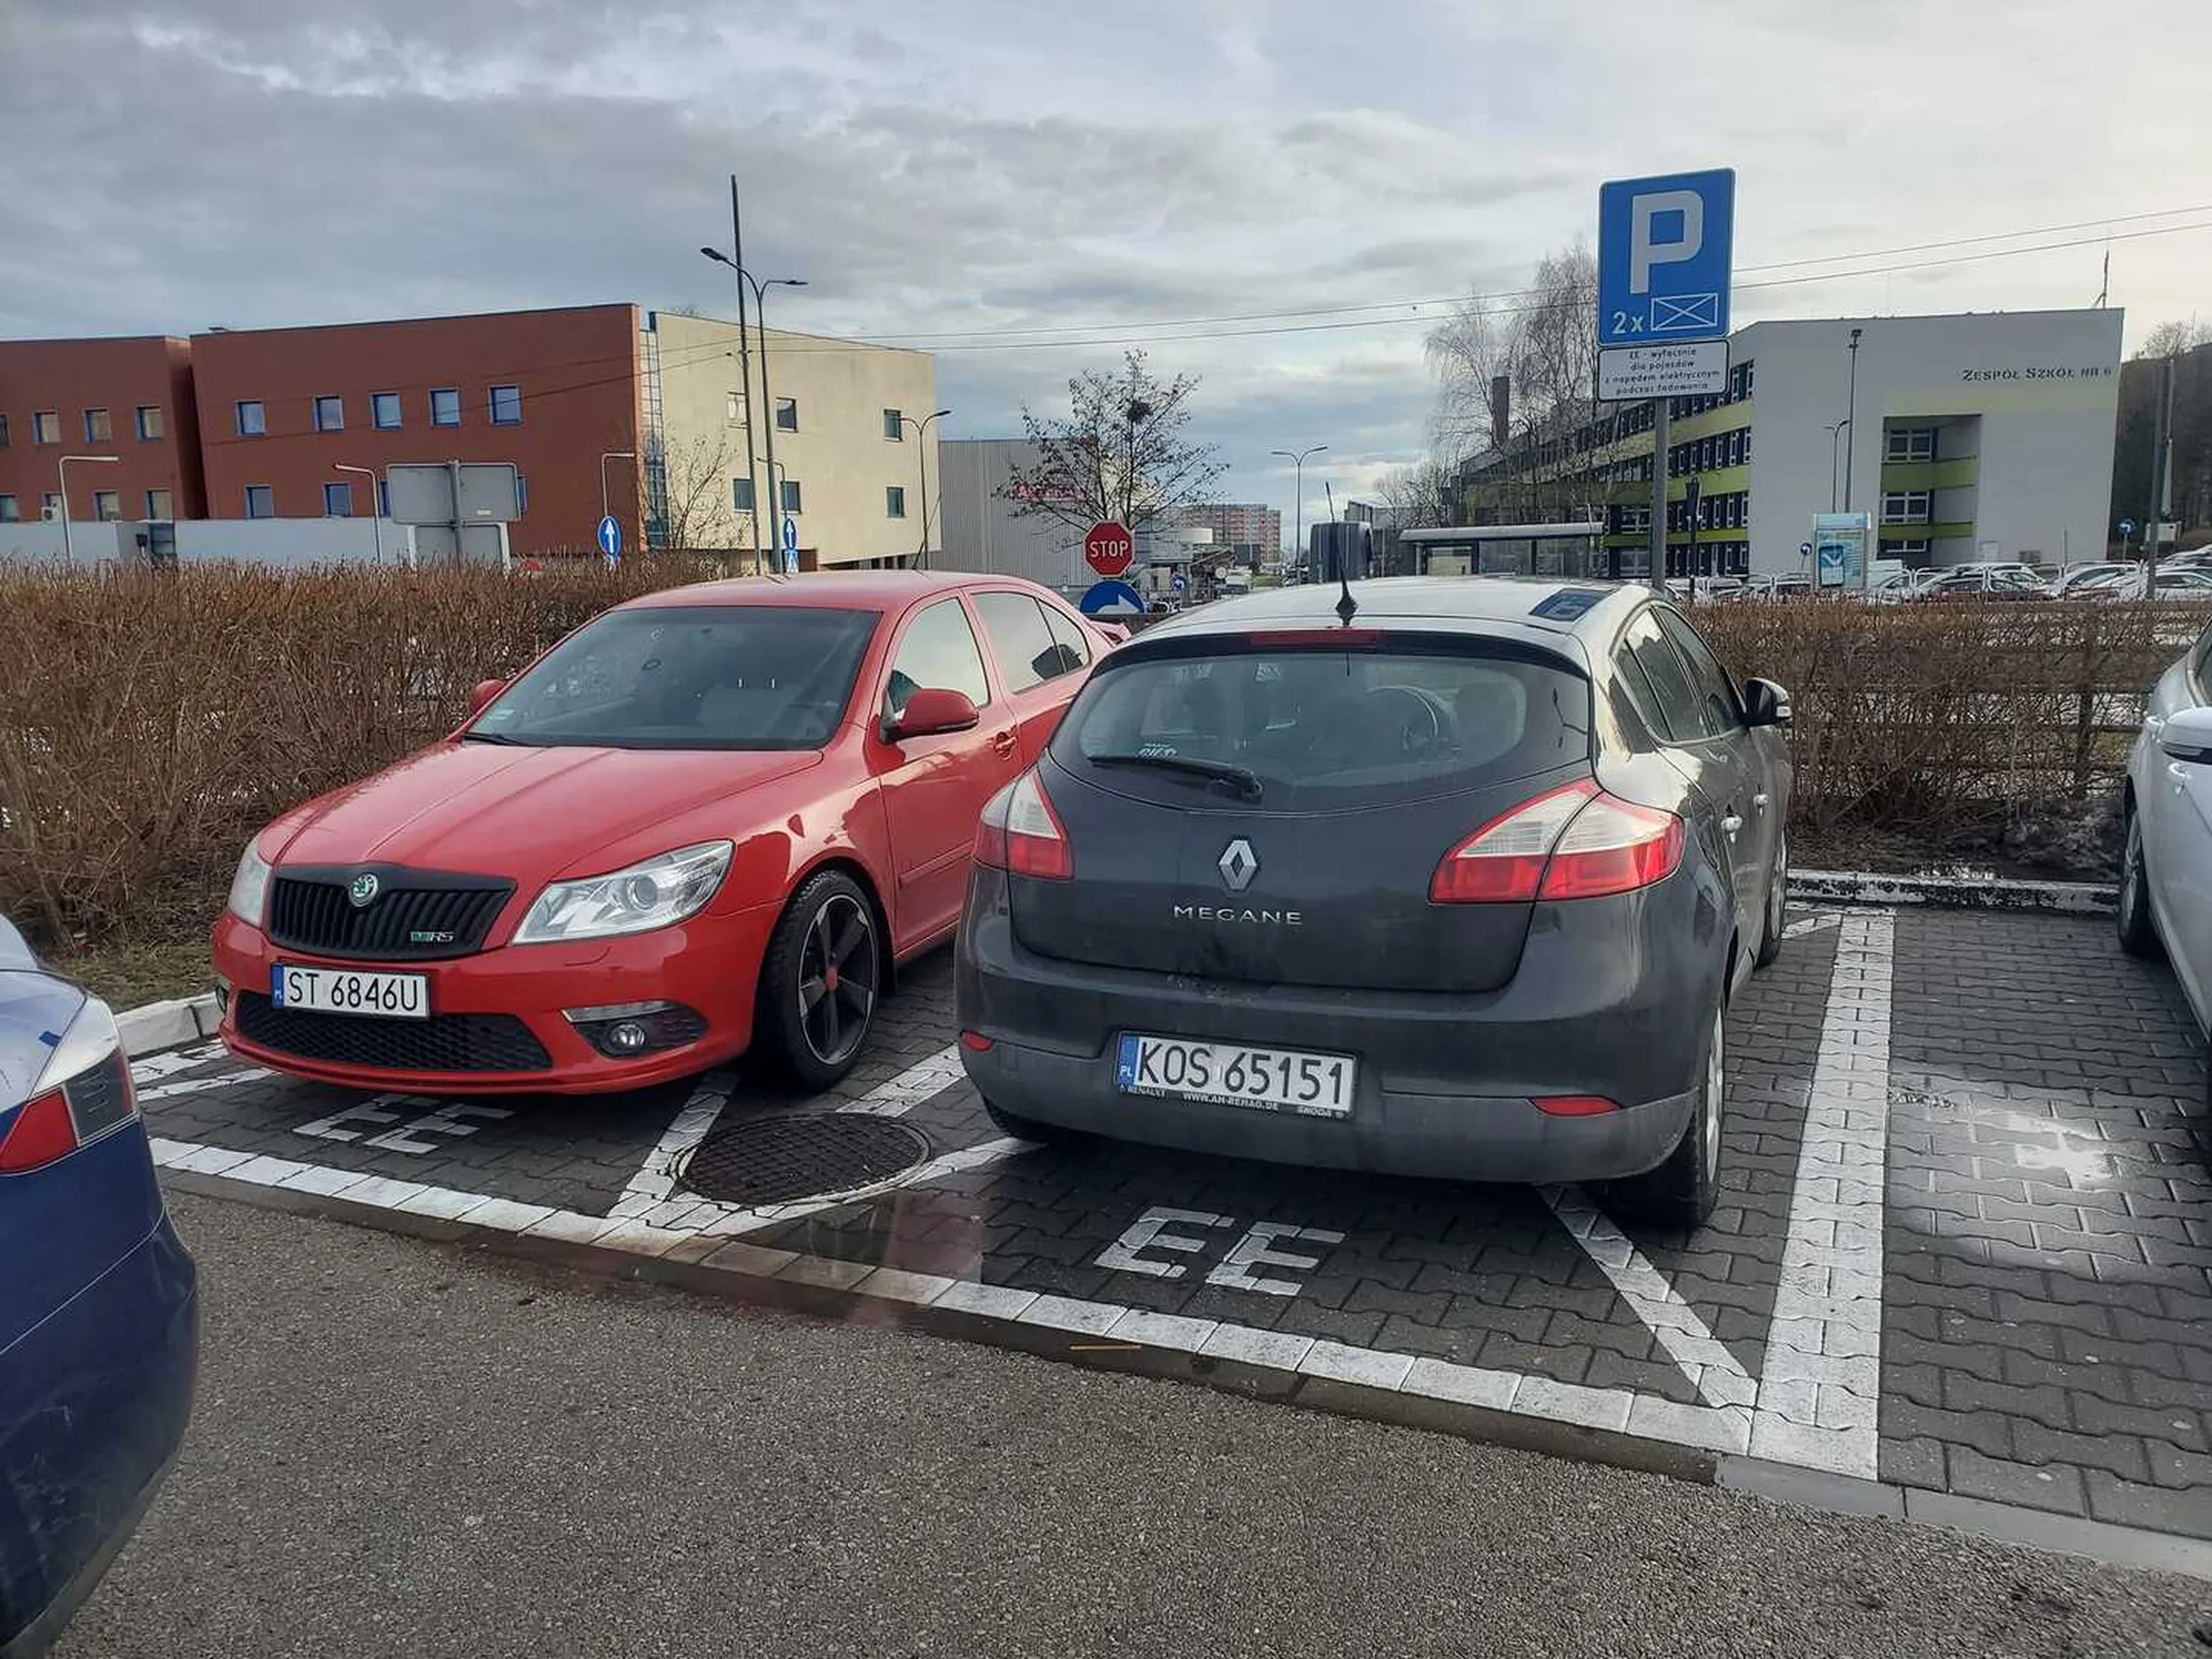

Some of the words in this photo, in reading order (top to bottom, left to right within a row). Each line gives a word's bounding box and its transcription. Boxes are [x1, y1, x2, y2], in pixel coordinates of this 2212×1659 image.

[1630, 189, 1704, 295] P
[1630, 361, 1646, 371] dla
[1649, 359, 1694, 371] pojazdów
[1612, 373, 1656, 385] napędem
[1660, 370, 1720, 380] elektrycznym
[1616, 386, 1654, 396] podczas
[1657, 382, 1708, 392] ładowania
[1089, 540, 1129, 557] STOP
[1173, 905, 1303, 926] MEGANE
[288, 972, 319, 1004] ST
[331, 976, 418, 1011] 6846U
[1119, 1064, 1133, 1078] PL
[1138, 1041, 1211, 1088] KOS
[1225, 1051, 1343, 1105] 65151
[1093, 1205, 1347, 1296] EE
